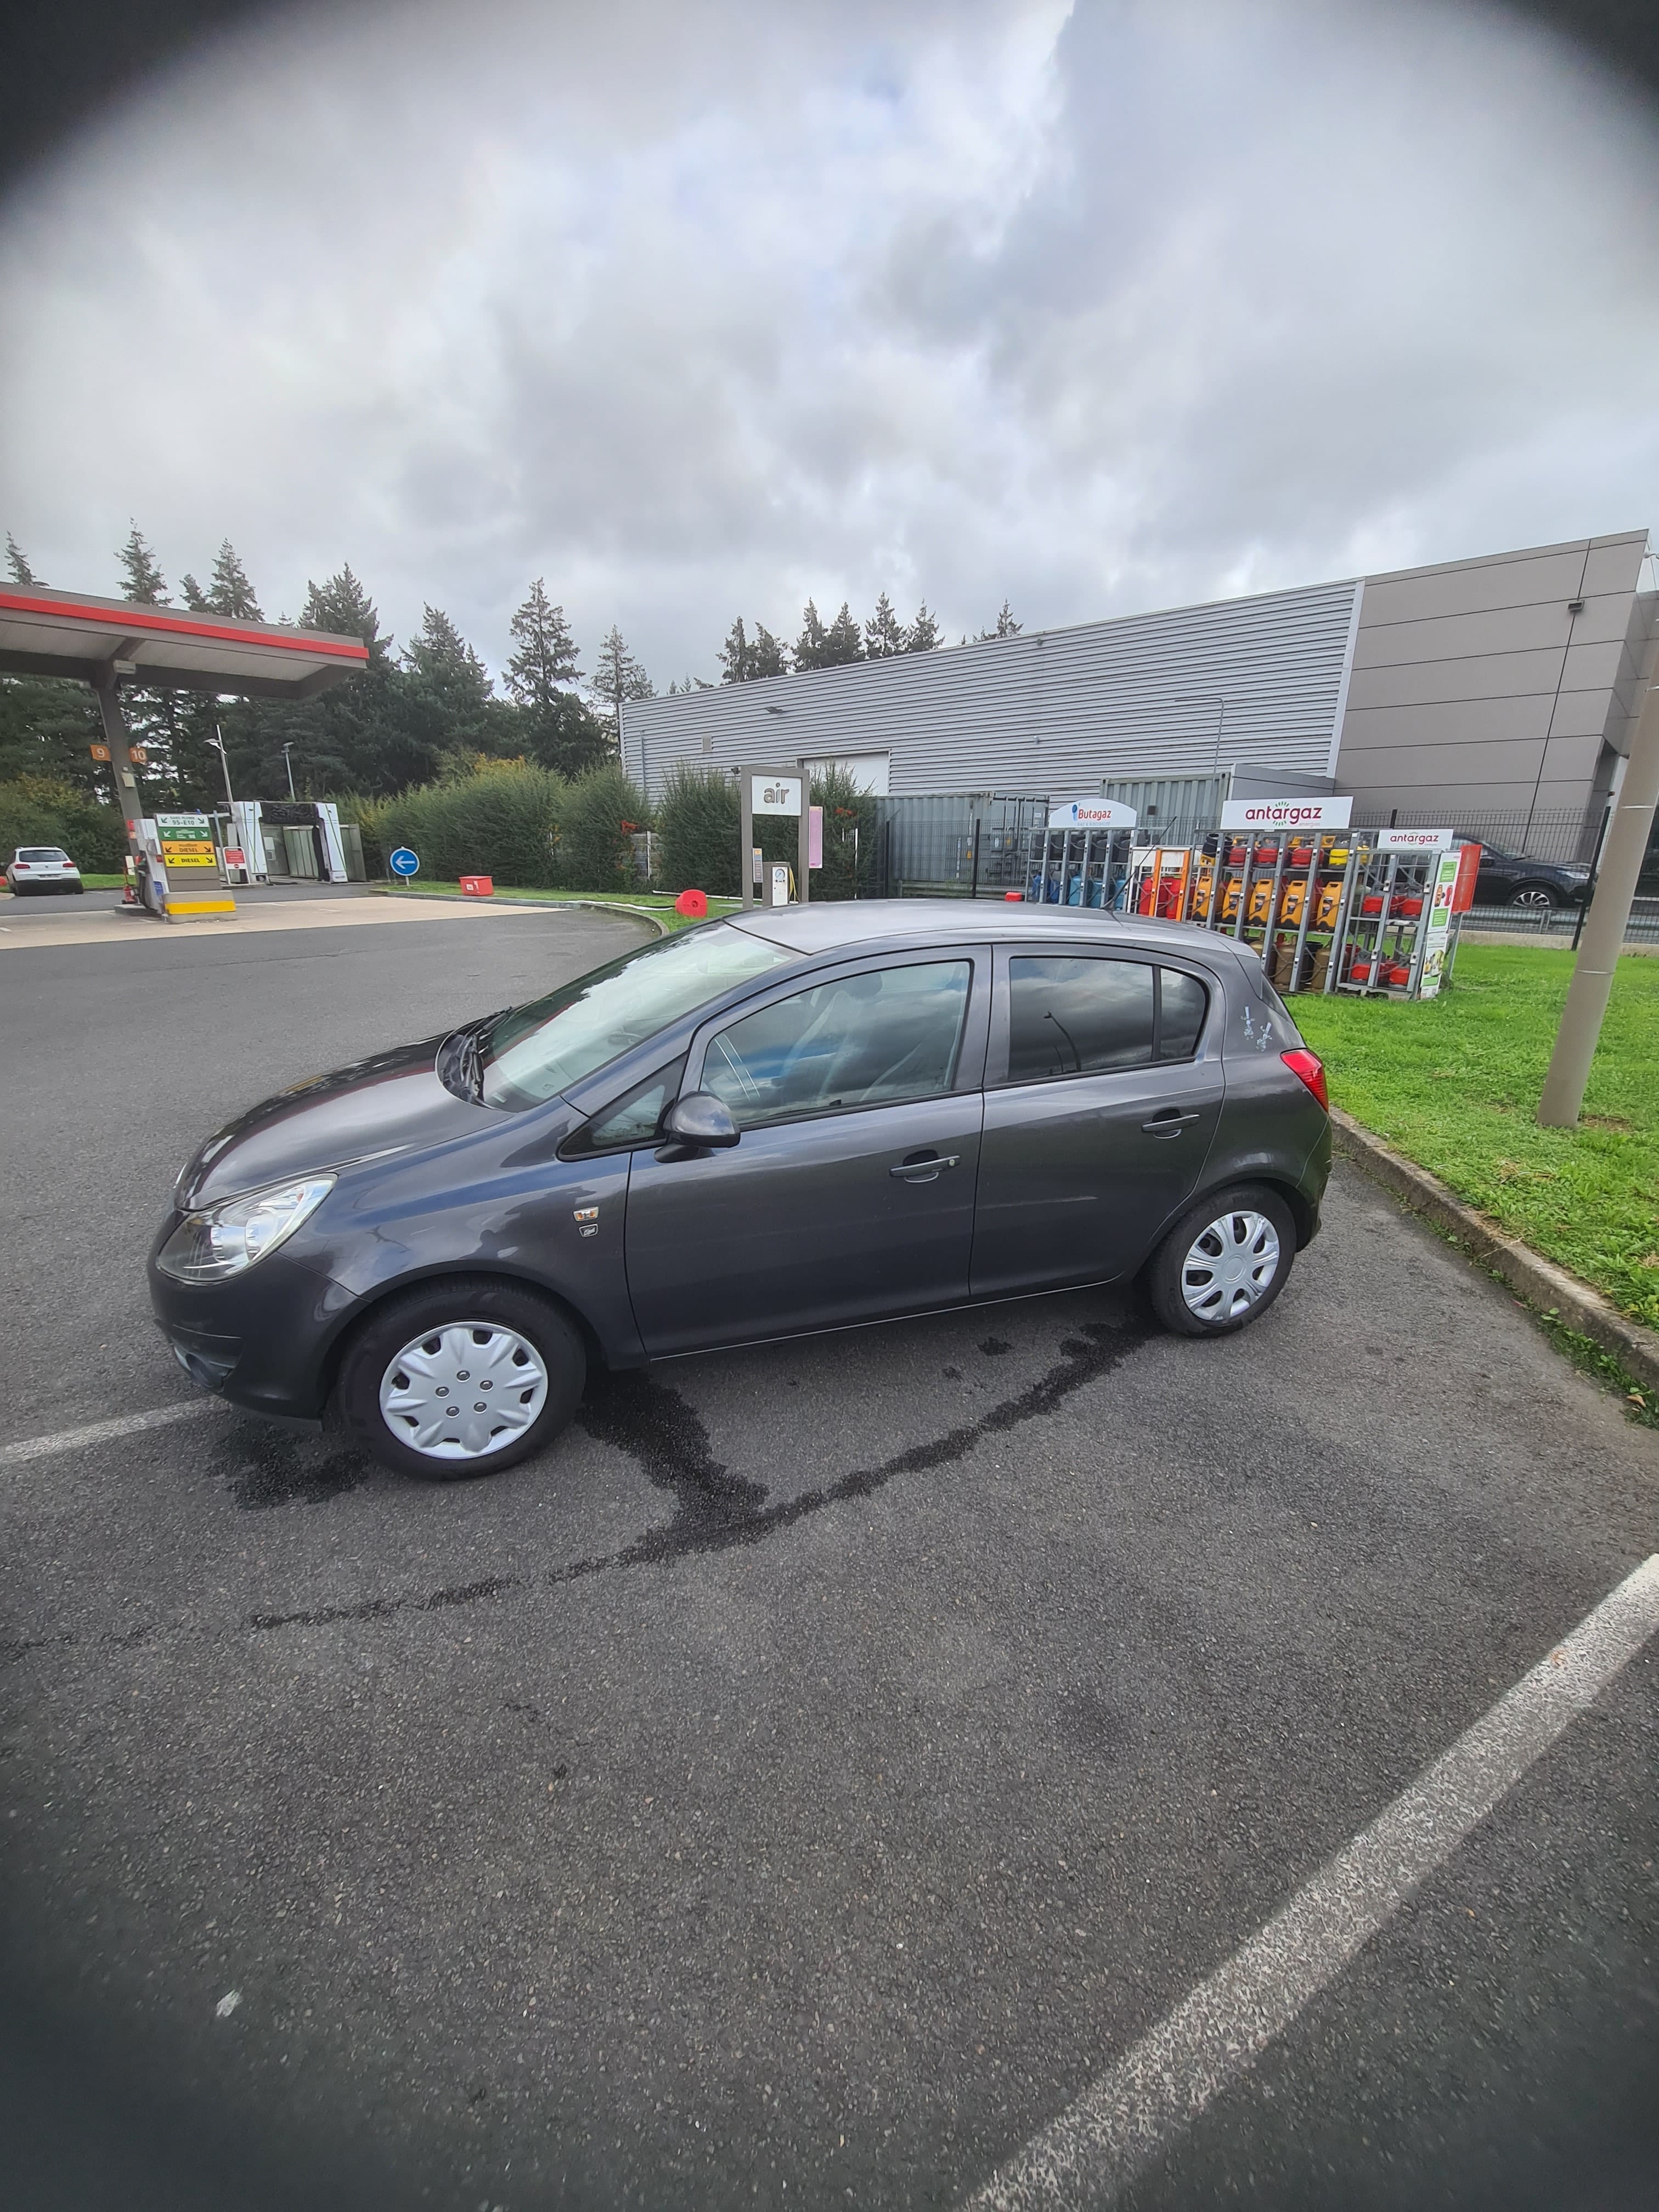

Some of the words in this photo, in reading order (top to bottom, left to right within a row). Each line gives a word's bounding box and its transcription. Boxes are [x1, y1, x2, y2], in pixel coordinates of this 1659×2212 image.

[97, 748, 105, 758] 9
[132, 750, 146, 760] 10
[764, 782, 789, 804] air
[1078, 809, 1111, 821] Butagaz
[1245, 806, 1323, 825] antargaz
[1390, 834, 1440, 845] antargaz
